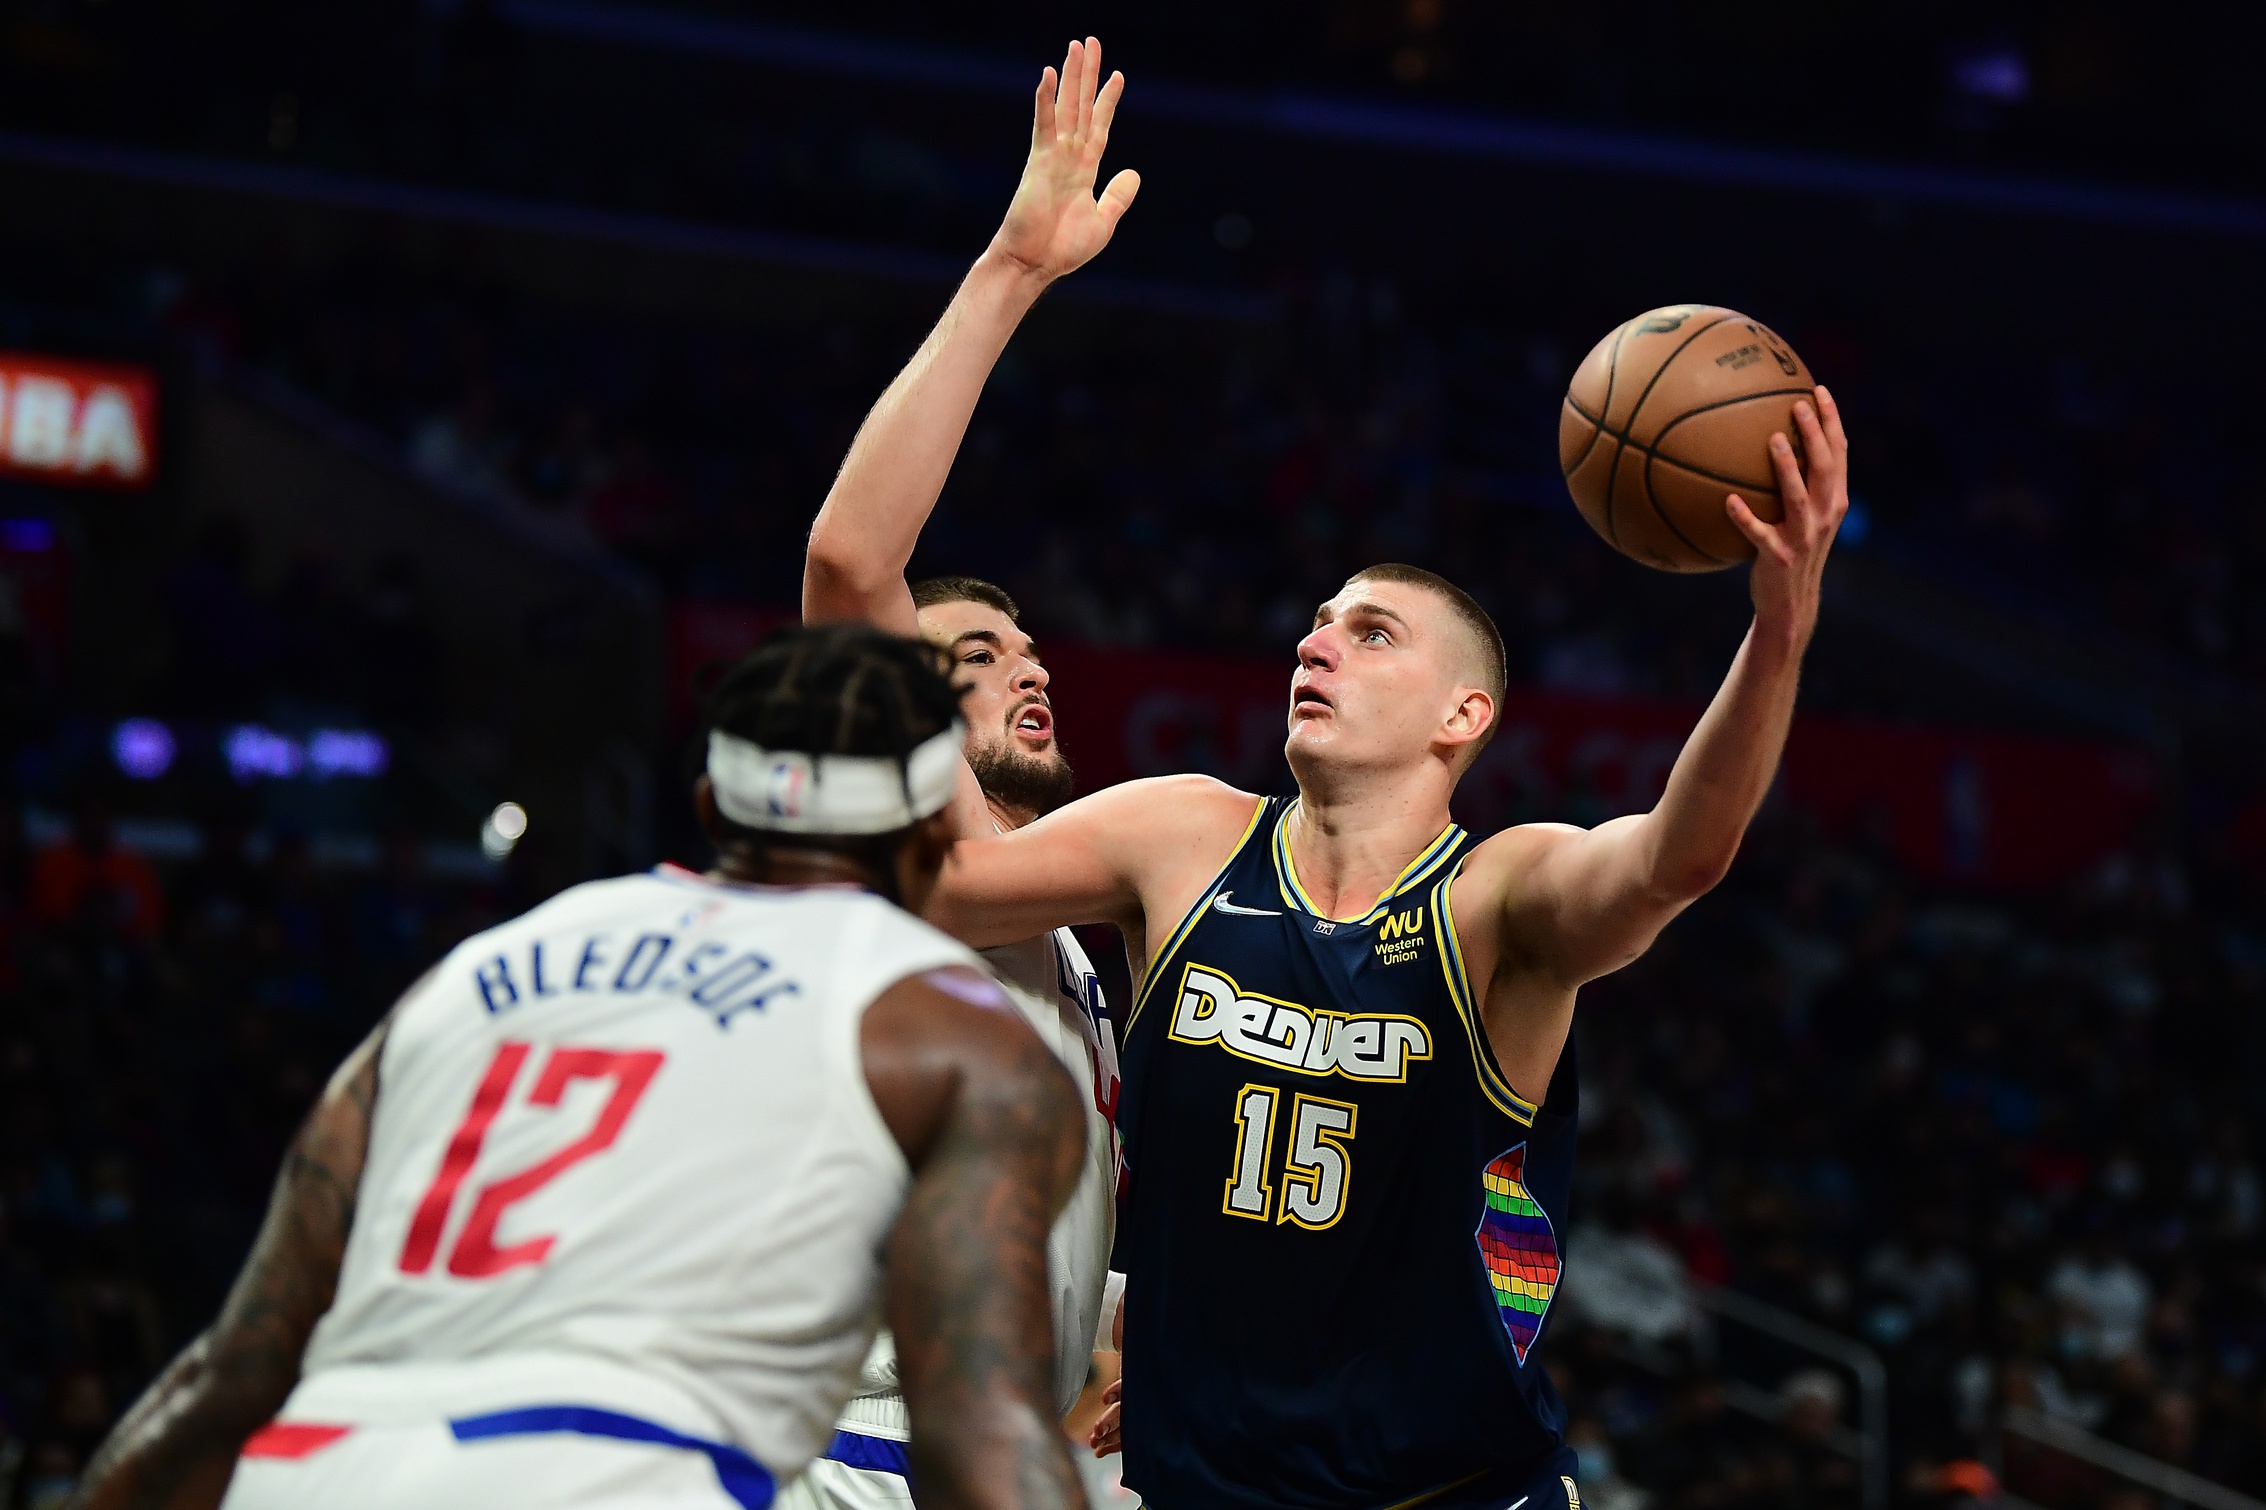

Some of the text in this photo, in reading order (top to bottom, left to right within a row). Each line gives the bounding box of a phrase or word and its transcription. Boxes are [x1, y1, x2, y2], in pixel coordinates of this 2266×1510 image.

[0, 372, 148, 482] BA
[1374, 936, 1425, 956] Western
[1379, 906, 1424, 941] WU
[1383, 950, 1418, 966] Union
[476, 933, 800, 1030] BLEDSOE
[398, 1041, 666, 1279] 12
[1222, 1083, 1358, 1231] 15
